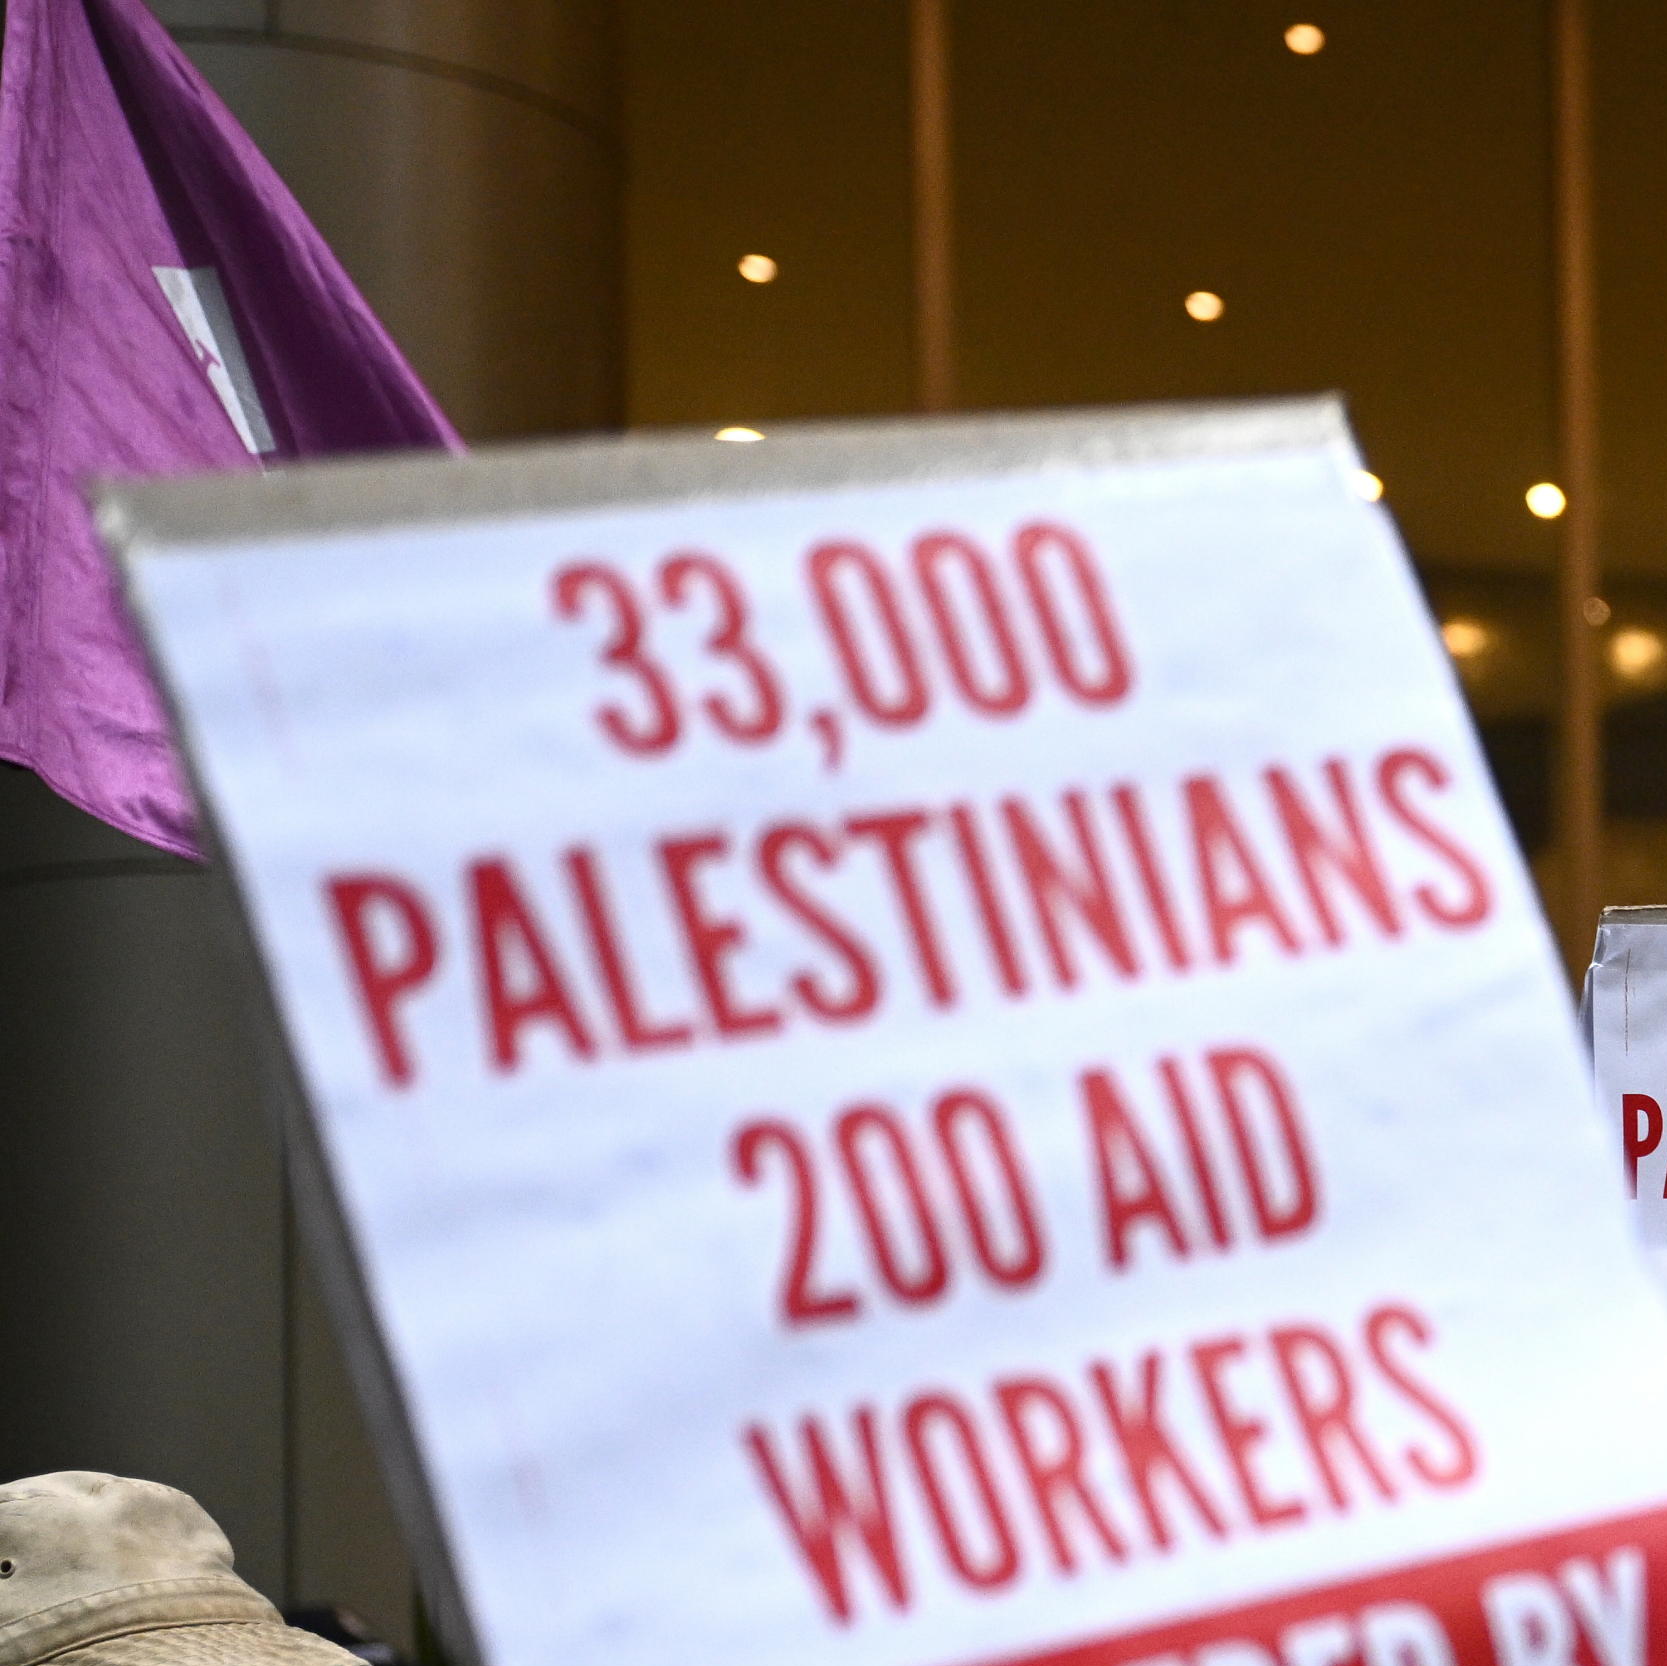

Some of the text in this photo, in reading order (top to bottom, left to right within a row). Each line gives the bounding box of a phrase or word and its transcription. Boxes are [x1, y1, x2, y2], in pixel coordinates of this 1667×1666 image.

[553, 520, 1135, 766] 33,000
[322, 746, 1494, 1090] PALESTINIANS
[730, 1046, 1320, 1328] 200 AID
[743, 1304, 1482, 1626] WORKERS
